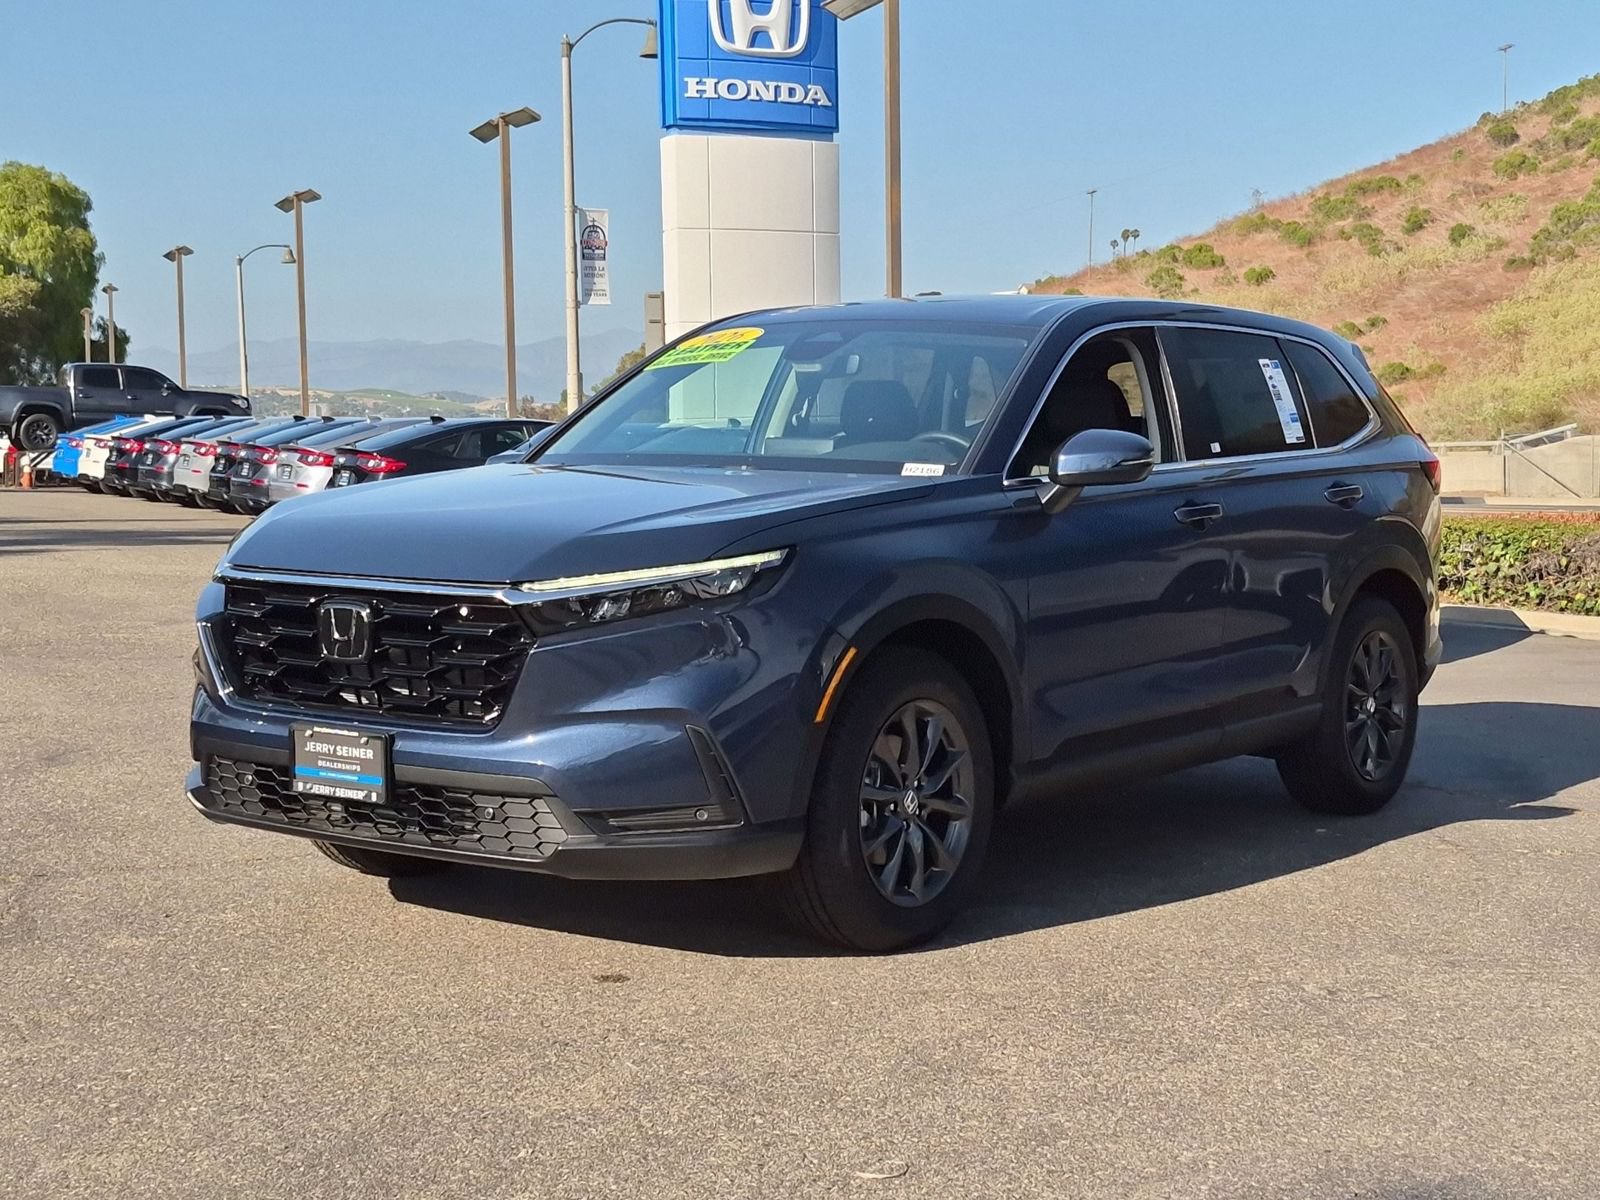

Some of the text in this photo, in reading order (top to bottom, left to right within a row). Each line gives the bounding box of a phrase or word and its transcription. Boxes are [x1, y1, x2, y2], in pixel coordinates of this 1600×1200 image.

[684, 77, 832, 106] HONDA
[304, 741, 374, 760] JERRY SEINER
[318, 760, 361, 772] DEALERSHIPS
[311, 783, 364, 800] JERRY SEINER
